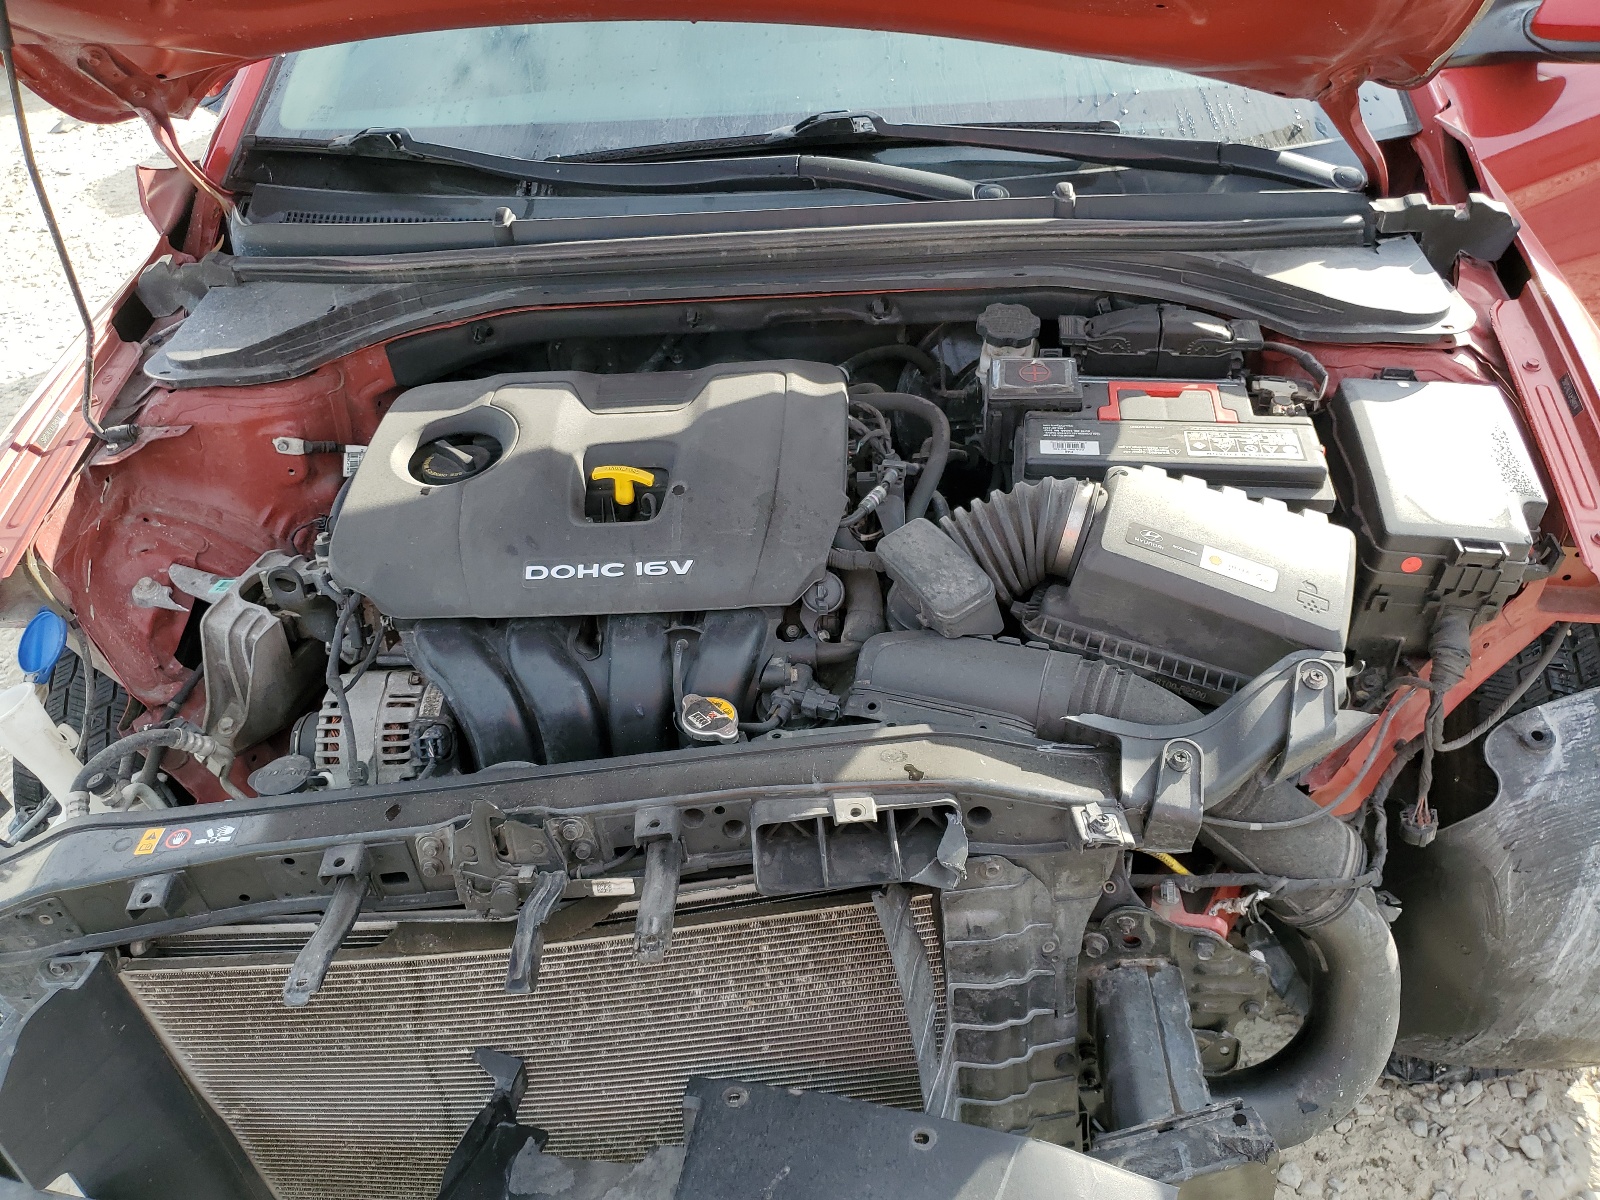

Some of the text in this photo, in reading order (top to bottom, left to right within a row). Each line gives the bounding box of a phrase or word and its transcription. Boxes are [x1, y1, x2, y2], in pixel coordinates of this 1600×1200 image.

[1134, 536, 1164, 550] HYUNDAI
[525, 559, 694, 580] DOHC 16V
